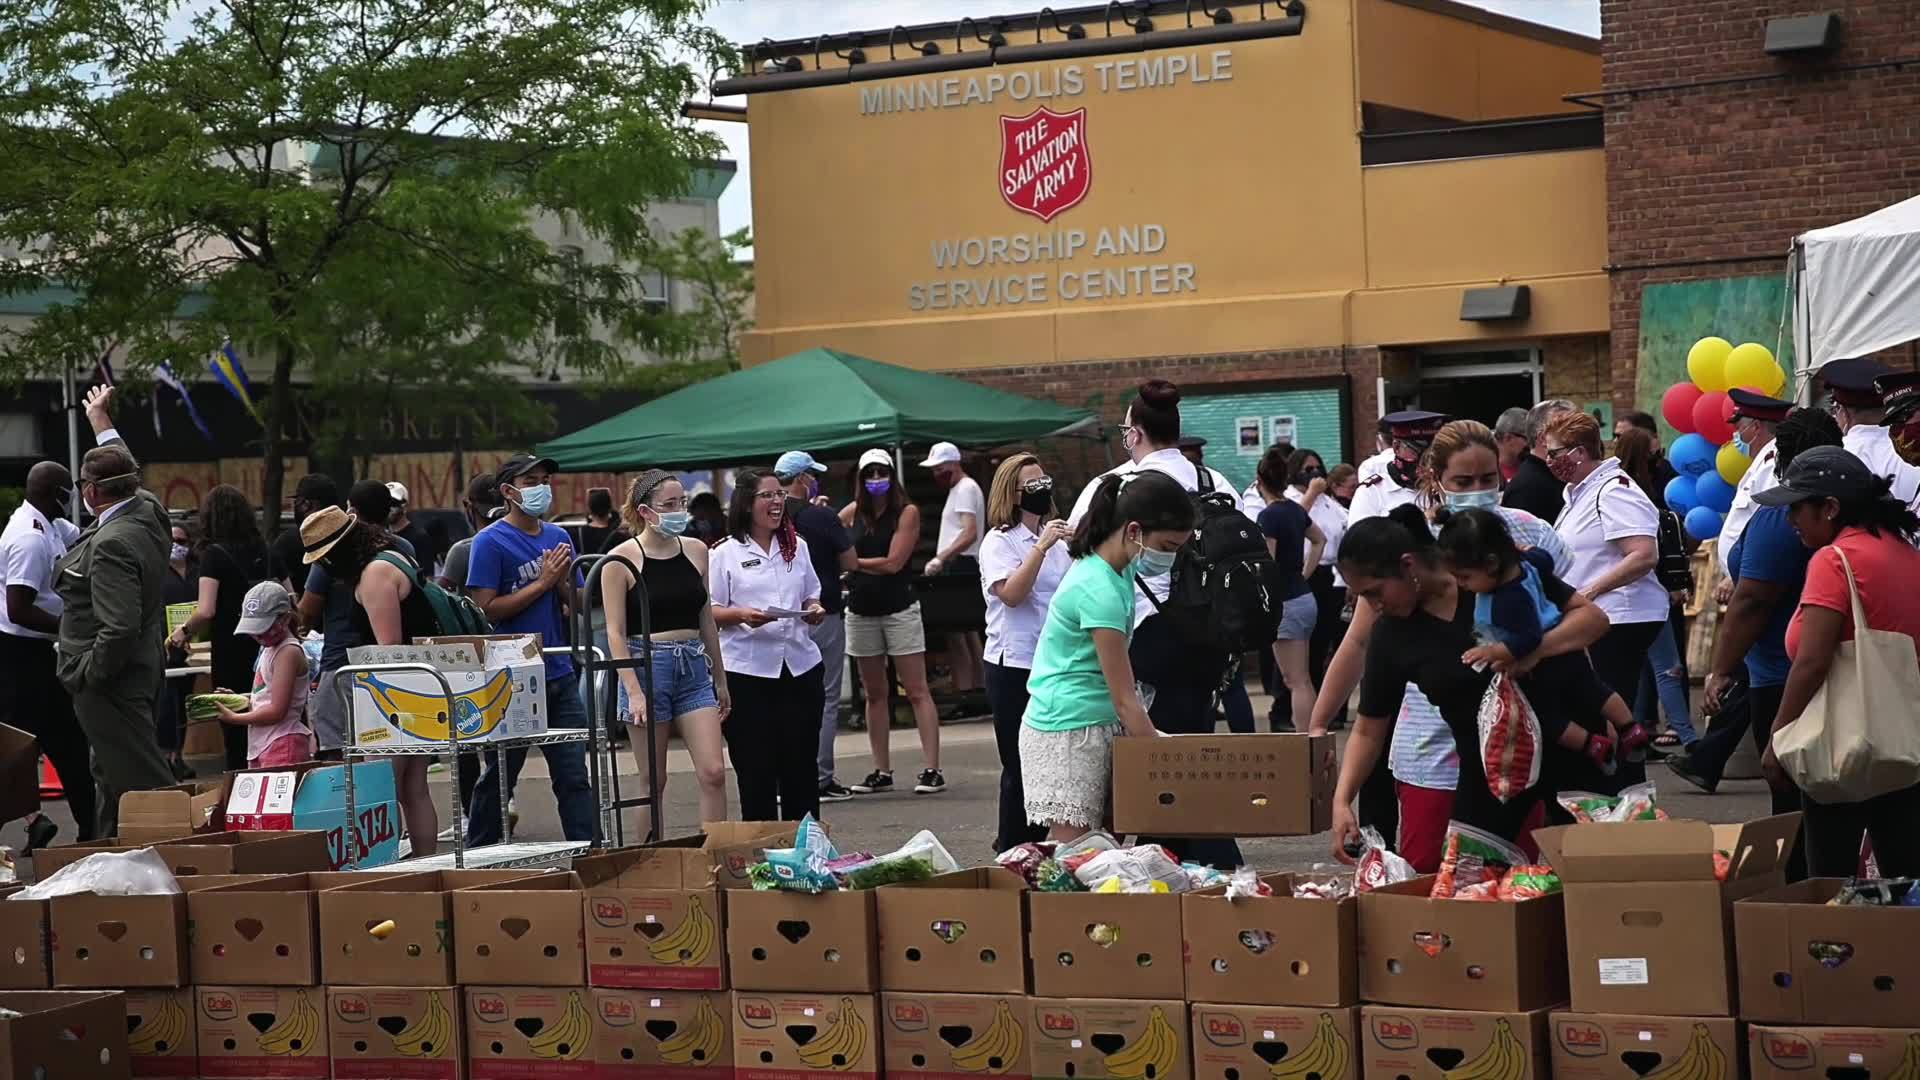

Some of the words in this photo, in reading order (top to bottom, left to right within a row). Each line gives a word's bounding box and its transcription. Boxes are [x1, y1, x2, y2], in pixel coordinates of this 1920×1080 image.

[859, 65, 1084, 114] MINNEAPOLIS
[1095, 50, 1233, 91] TEMPLE
[1015, 118, 1049, 155] THE
[1005, 121, 1078, 196] SALVATION
[1032, 153, 1077, 208] ARMY
[931, 230, 1087, 269] WORSHIP
[1094, 223, 1166, 257] AND
[911, 272, 1049, 311] SERVICE
[1057, 263, 1197, 300] CENTER
[456, 712, 482, 732] Chiquita
[597, 903, 624, 917] Dole
[208, 997, 233, 1009] Dole
[341, 999, 368, 1011] Dole
[480, 999, 504, 1011] Dole
[745, 1004, 772, 1017] Dole
[896, 1006, 923, 1019] Dole
[1045, 1014, 1074, 1028] Dole
[1209, 1019, 1240, 1033] Dole
[1381, 1021, 1413, 1036] Dole
[1567, 1027, 1601, 1042] Dole
[1770, 1040, 1808, 1055] Dole
